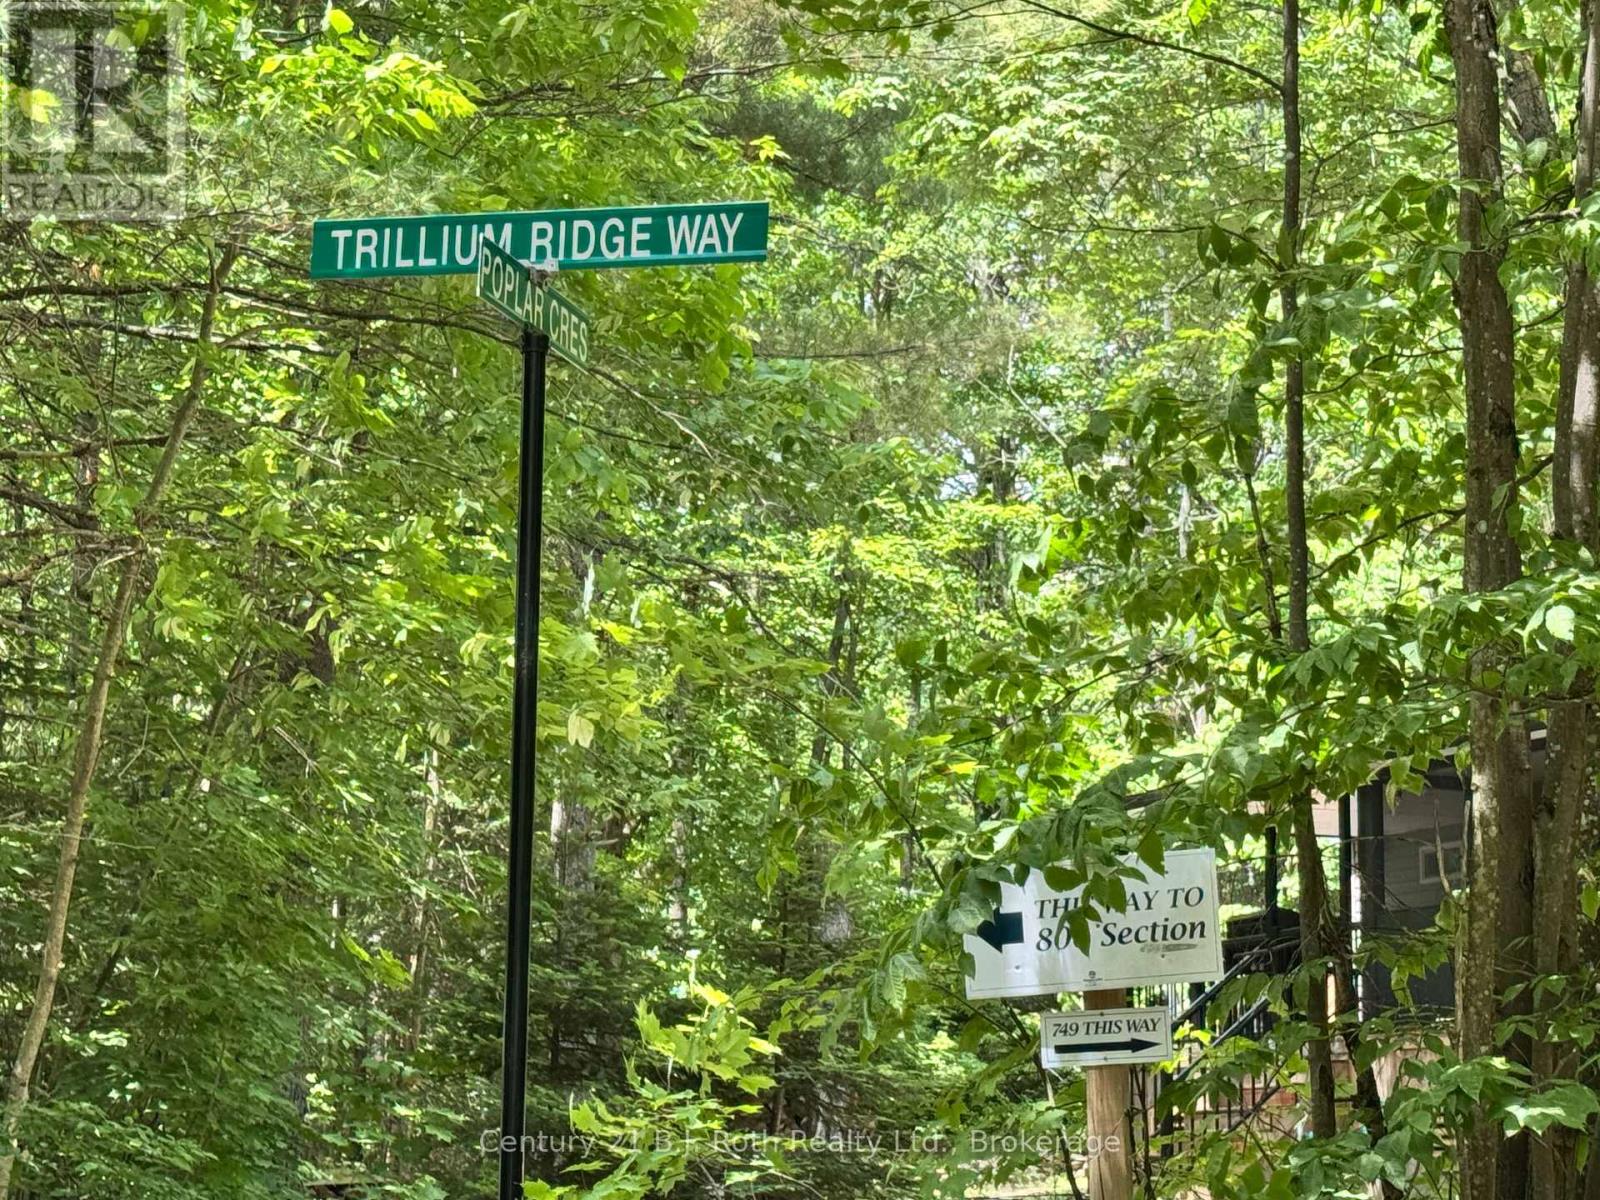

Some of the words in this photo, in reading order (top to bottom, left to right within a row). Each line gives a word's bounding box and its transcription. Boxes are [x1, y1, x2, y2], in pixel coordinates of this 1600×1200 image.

[331, 223, 512, 270] TRILLIUM
[529, 216, 652, 264] RIDGE
[667, 212, 744, 256] WAY
[480, 246, 545, 330] POPLAR
[549, 299, 588, 362] CRES
[1167, 886, 1204, 909] TO
[1101, 917, 1206, 947] Section
[1052, 1022, 1080, 1037] 749
[1083, 1019, 1122, 1035] THIS
[1126, 1018, 1161, 1033] WAY
